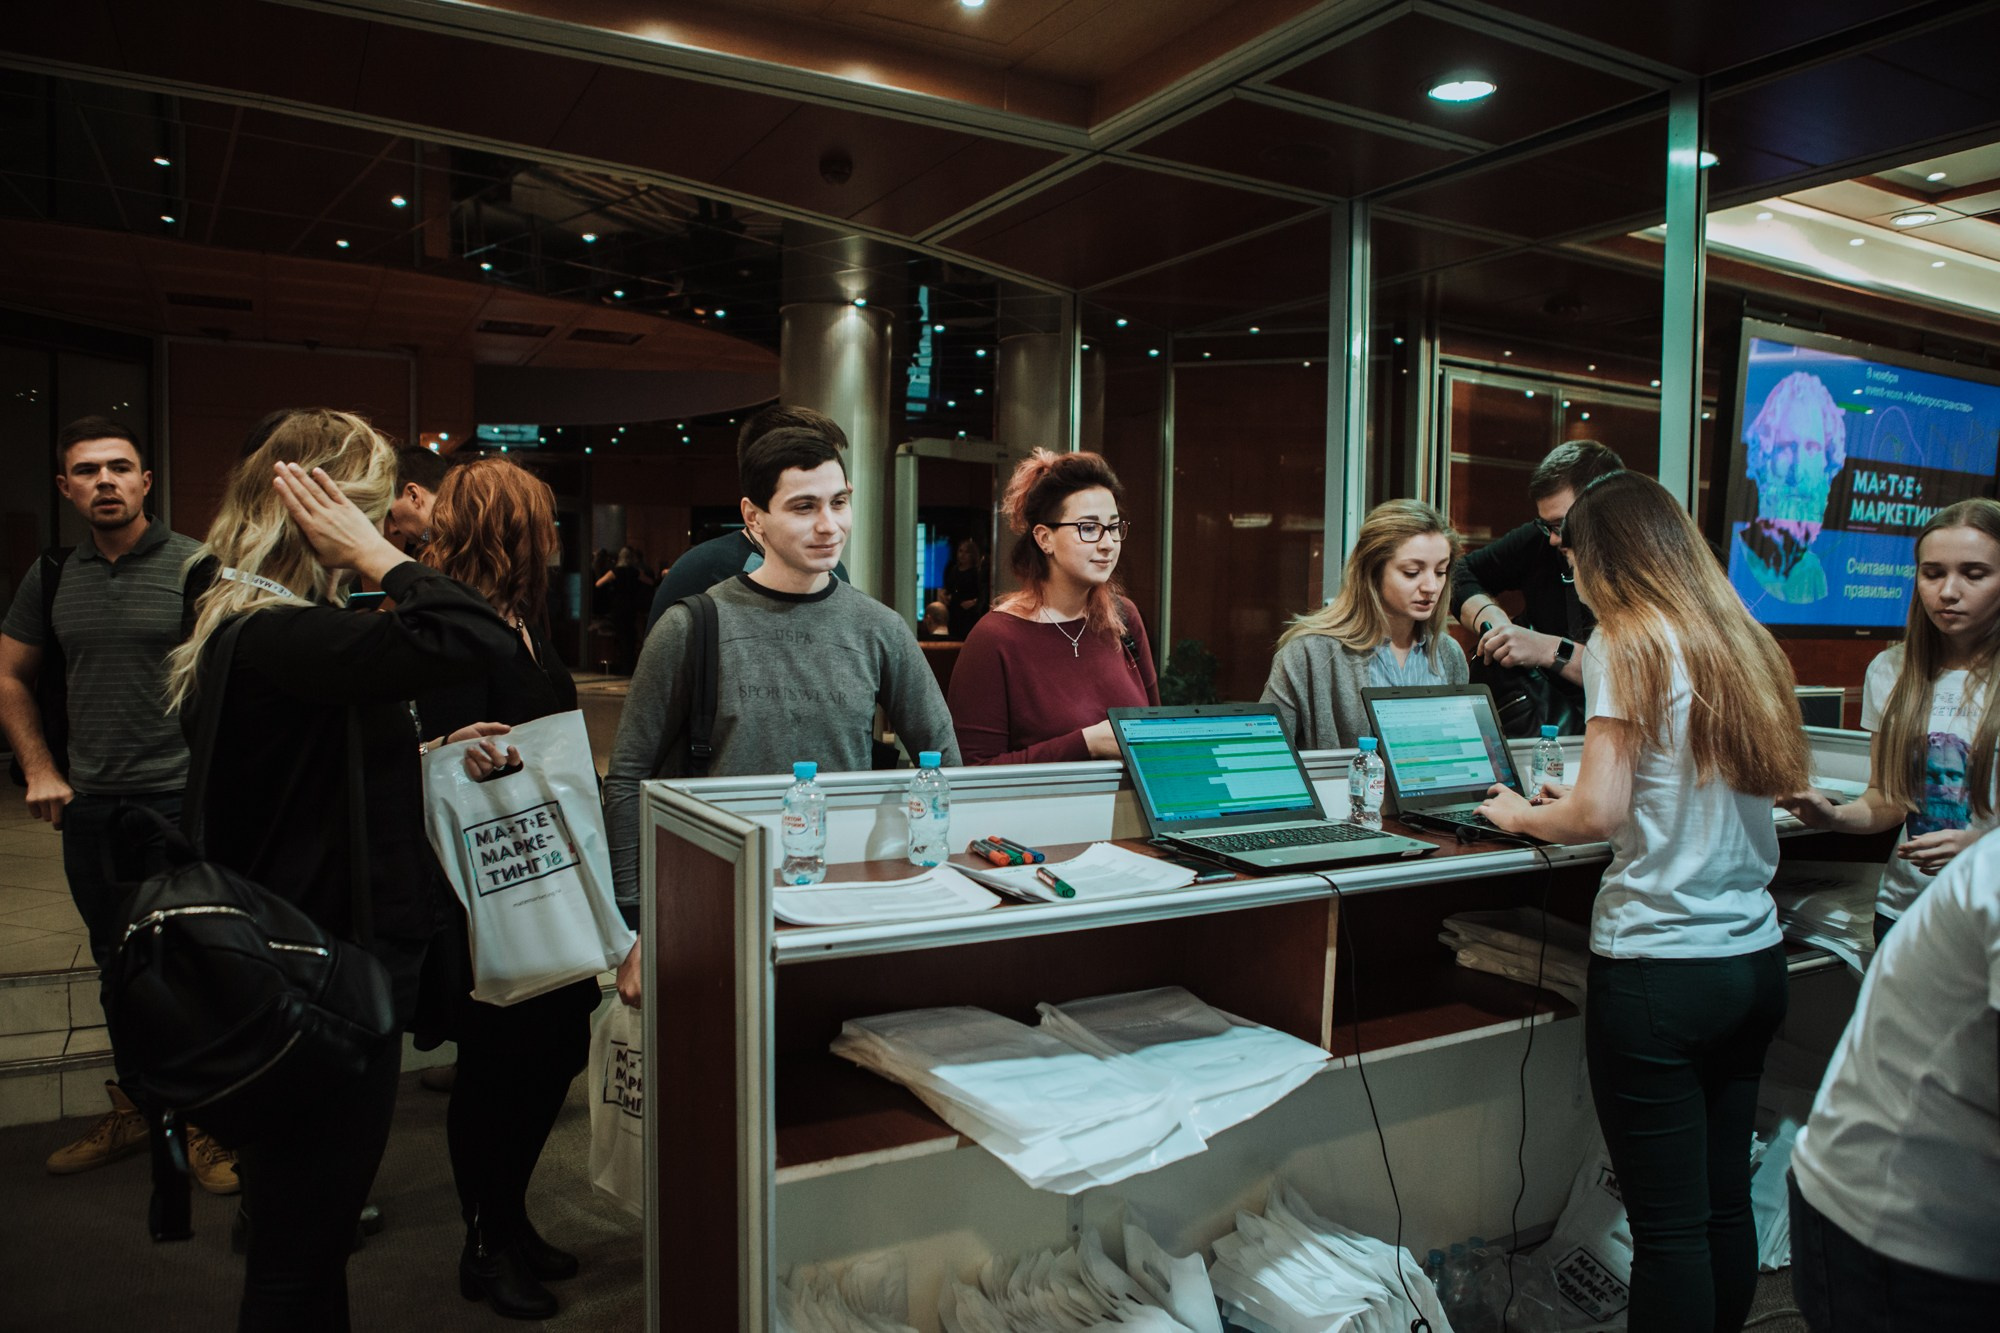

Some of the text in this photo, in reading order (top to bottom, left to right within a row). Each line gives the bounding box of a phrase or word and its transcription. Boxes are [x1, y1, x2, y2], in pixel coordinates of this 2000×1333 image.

[1850, 498, 1946, 527] МАРКЕТИН
[1847, 557, 1917, 581] Считаем мар
[1844, 584, 1902, 600] правильно
[775, 629, 813, 645] USPA
[738, 685, 848, 705] SPORTSWEAR
